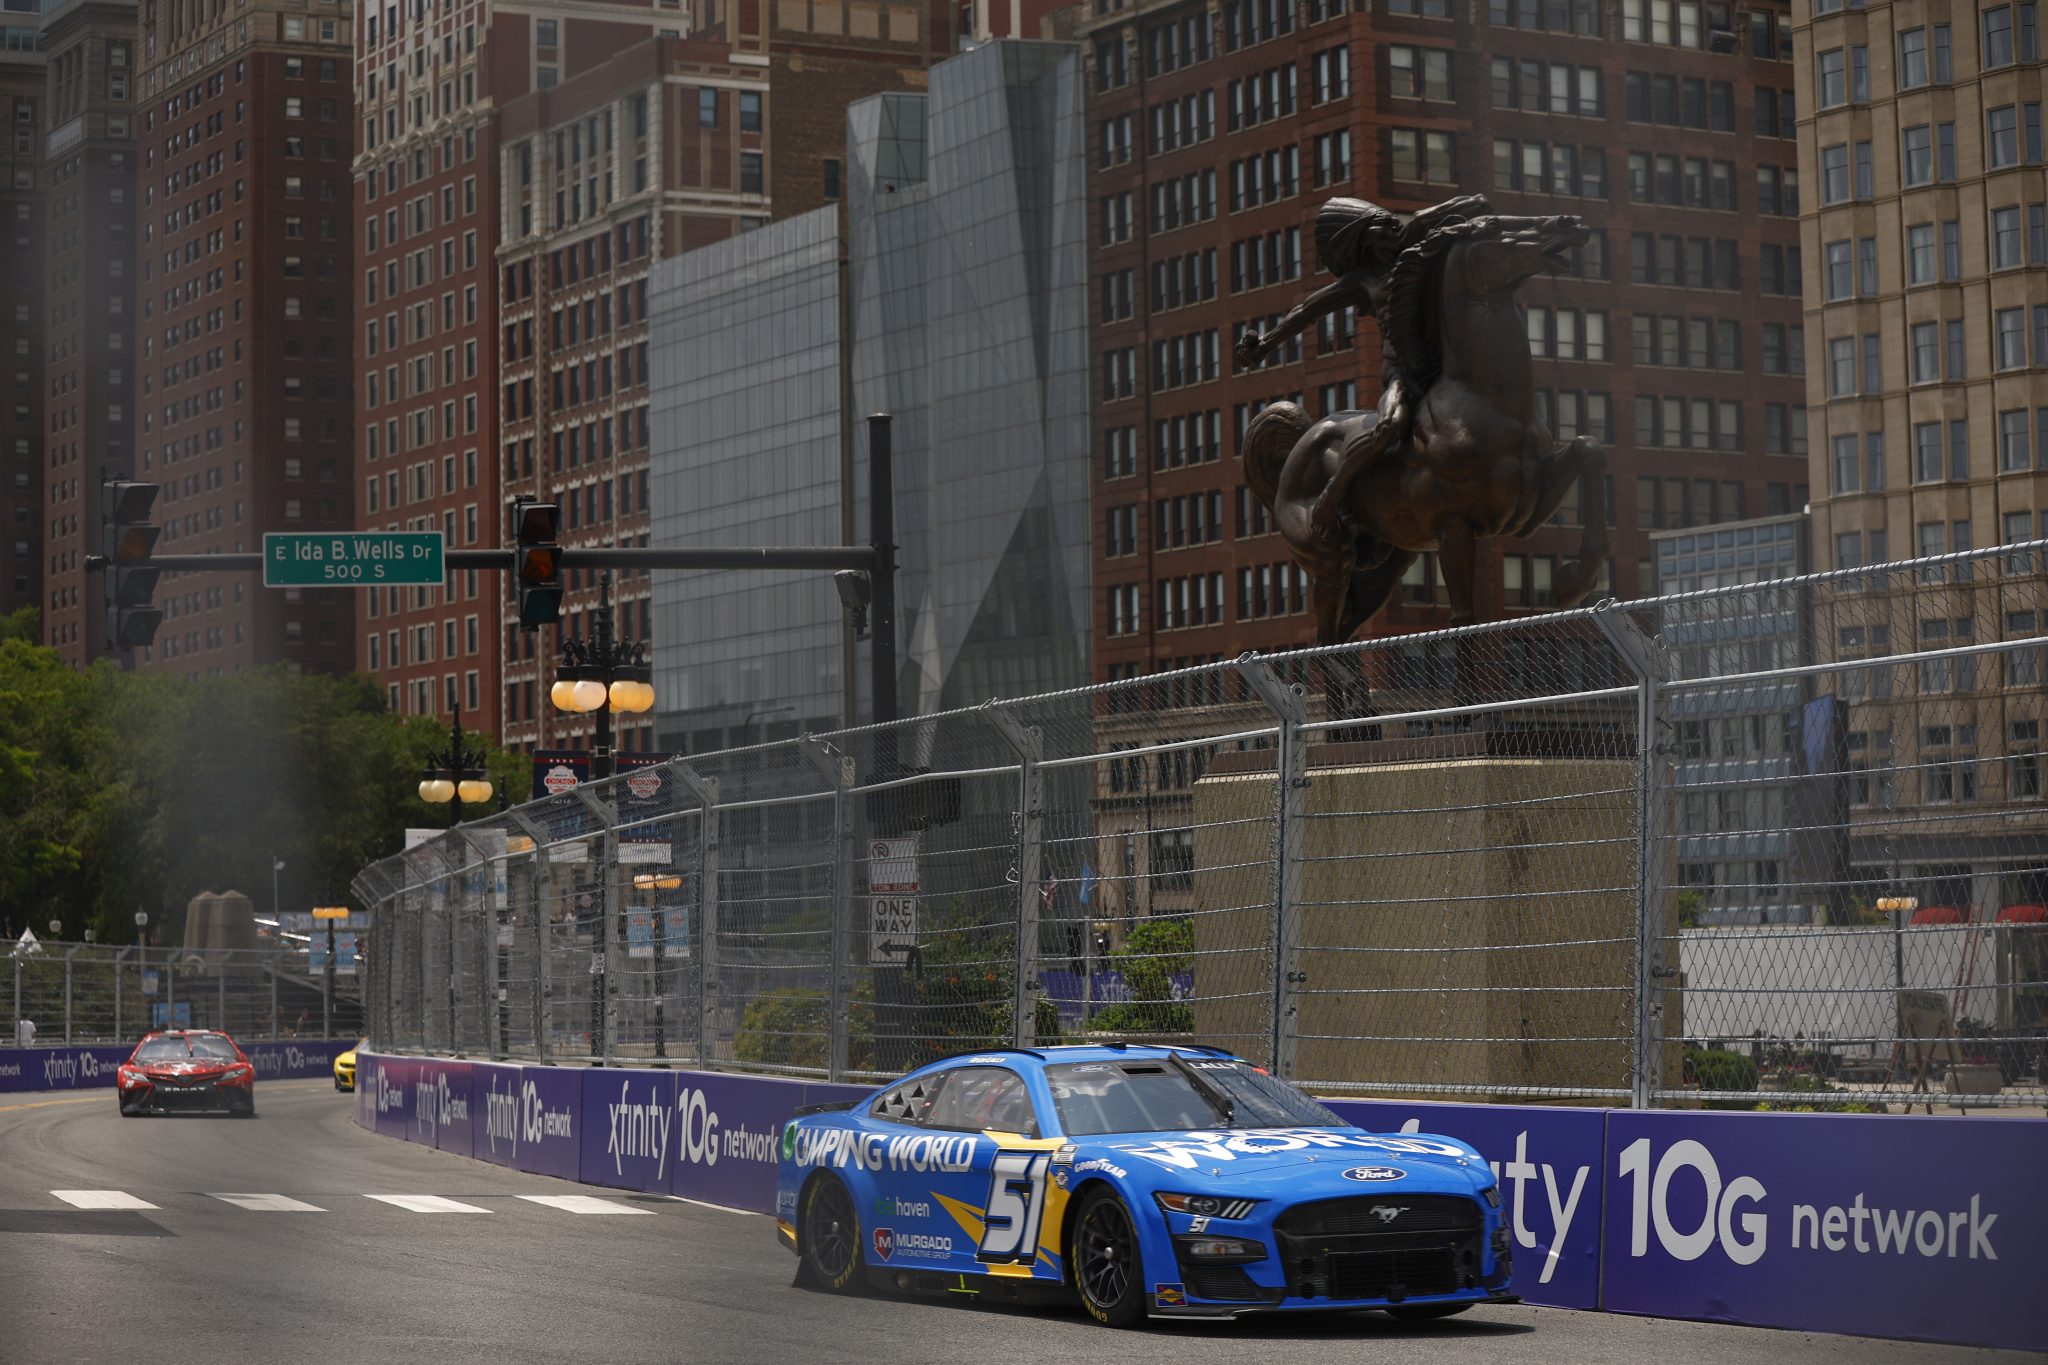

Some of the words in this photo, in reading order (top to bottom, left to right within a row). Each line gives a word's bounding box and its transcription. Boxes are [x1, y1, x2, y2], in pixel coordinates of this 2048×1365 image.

[276, 546, 286, 560] E
[295, 541, 323, 561] Ida
[332, 540, 349, 561] B.
[354, 540, 405, 560] Wells
[412, 545, 432, 560] Dr
[324, 565, 362, 579] 500
[374, 564, 385, 578] S
[876, 900, 912, 916] ONE
[875, 919, 912, 933] WAY
[285, 1046, 305, 1070] 10G
[306, 1053, 329, 1066] network
[1188, 1061, 1239, 1070] LALLY
[43, 1051, 78, 1087] xfinity
[80, 1052, 99, 1078] 10G
[415, 1065, 438, 1138] xfinity
[438, 1072, 451, 1126] 10G
[451, 1093, 468, 1121] network
[486, 1073, 519, 1159] xfinity
[522, 1080, 543, 1144] 10G
[544, 1105, 572, 1138] network
[608, 1080, 672, 1181] xfinity
[678, 1088, 719, 1167] 10G
[723, 1122, 780, 1164] network
[795, 1128, 889, 1172] CAMPING
[888, 1135, 978, 1173] WORLD
[1074, 1158, 1128, 1179] GOODYEAR
[979, 1152, 1052, 1260] 51
[1619, 1137, 1768, 1266] 10G
[1791, 1191, 1999, 1261] network
[1188, 1217, 1211, 1234] 51
[878, 1236, 892, 1249] M
[896, 1233, 952, 1251] MURGADO
